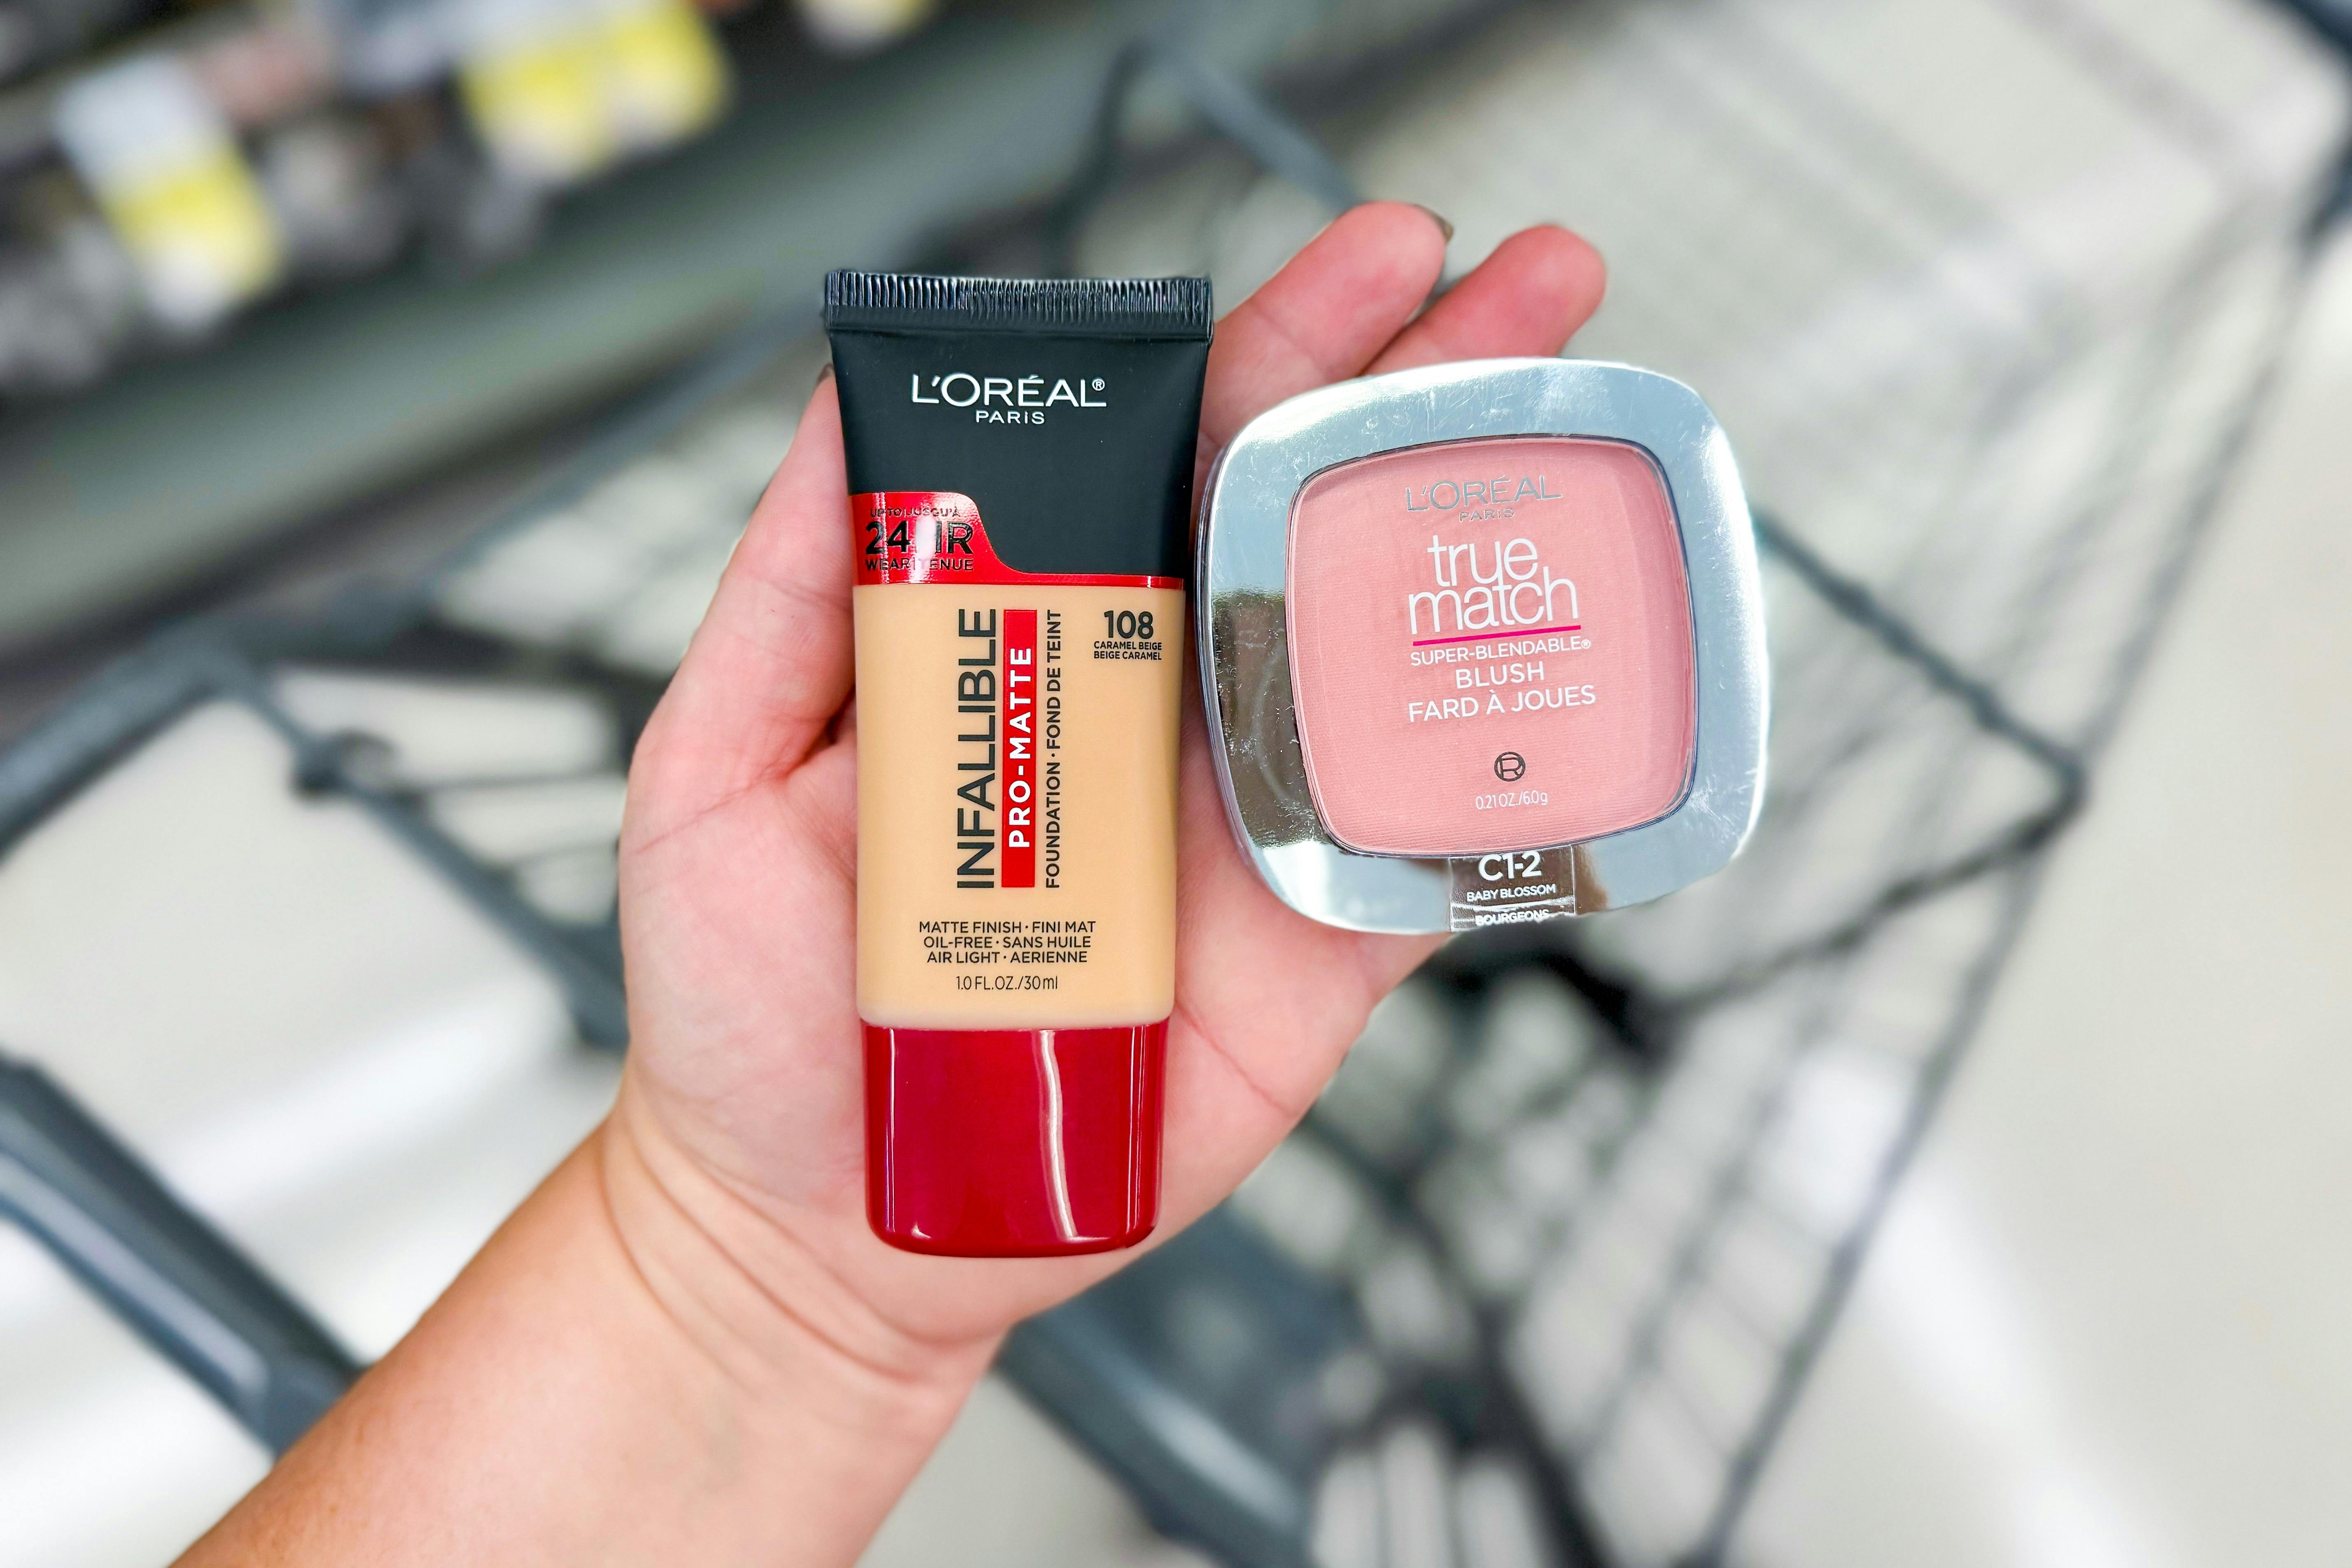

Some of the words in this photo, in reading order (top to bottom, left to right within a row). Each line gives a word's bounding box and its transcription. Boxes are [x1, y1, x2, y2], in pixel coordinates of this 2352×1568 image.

[1406, 475, 1562, 511] L'ORÉAL
[866, 520, 911, 554] 24
[922, 558, 973, 571] ENUE
[1427, 535, 1538, 587] true
[1408, 567, 1578, 635] match
[1047, 609, 1062, 663] TEINT
[1104, 610, 1153, 639] 108
[1094, 641, 1136, 649] CARAMEL
[1139, 642, 1162, 650] BEIGE
[1122, 651, 1162, 660] CARAMEL
[1047, 667, 1061, 692] DE
[1456, 661, 1545, 689] BLUSH
[1409, 696, 1479, 722] FARD
[1486, 689, 1505, 715] À
[1511, 685, 1596, 712] JOUES
[1046, 695, 1061, 749] FOND
[957, 609, 996, 889] INFALLIBLE
[1009, 647, 1032, 847] PRO-MATTE
[1046, 762, 1061, 888] FOUNDATION
[1478, 850, 1542, 881] C1-2
[1466, 889, 1498, 902] BABY
[1500, 883, 1556, 898] BLOSSOM
[919, 921, 969, 933] MATTE
[973, 921, 1022, 933] FINISH
[1032, 921, 1061, 933] FINI
[1065, 921, 1096, 933] MAT
[1475, 909, 1549, 926] BOURGEONS
[924, 936, 993, 948] OIL-FREE
[1003, 936, 1043, 948] SANS
[1047, 936, 1091, 947] HUILE
[927, 951, 952, 964] AIR
[957, 951, 1000, 963] LIGHT
[1010, 951, 1087, 963] AERIENNE
[956, 976, 972, 990] 1.0
